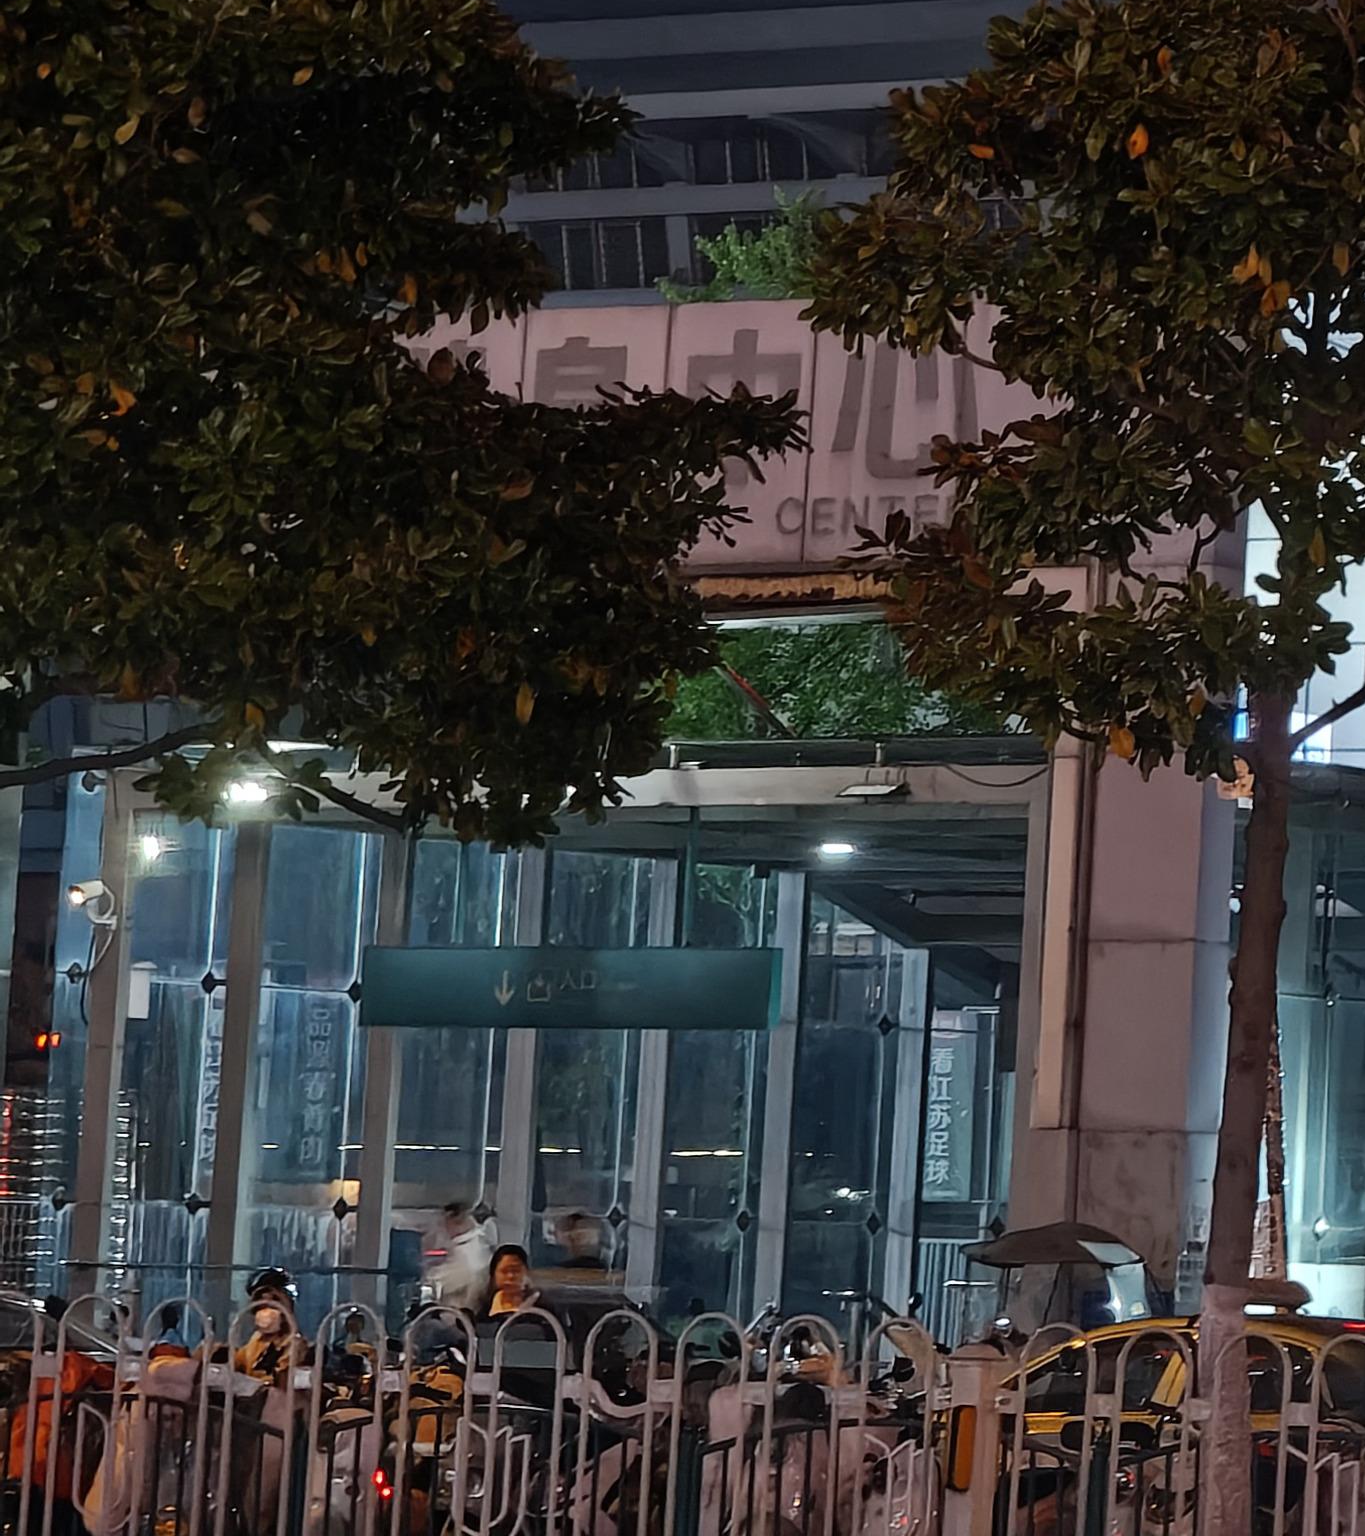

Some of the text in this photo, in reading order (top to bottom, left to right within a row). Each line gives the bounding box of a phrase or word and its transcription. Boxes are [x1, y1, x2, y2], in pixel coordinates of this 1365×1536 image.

[776, 495, 963, 537] CENTE
[924, 1047, 955, 1186] 看江苏足球
